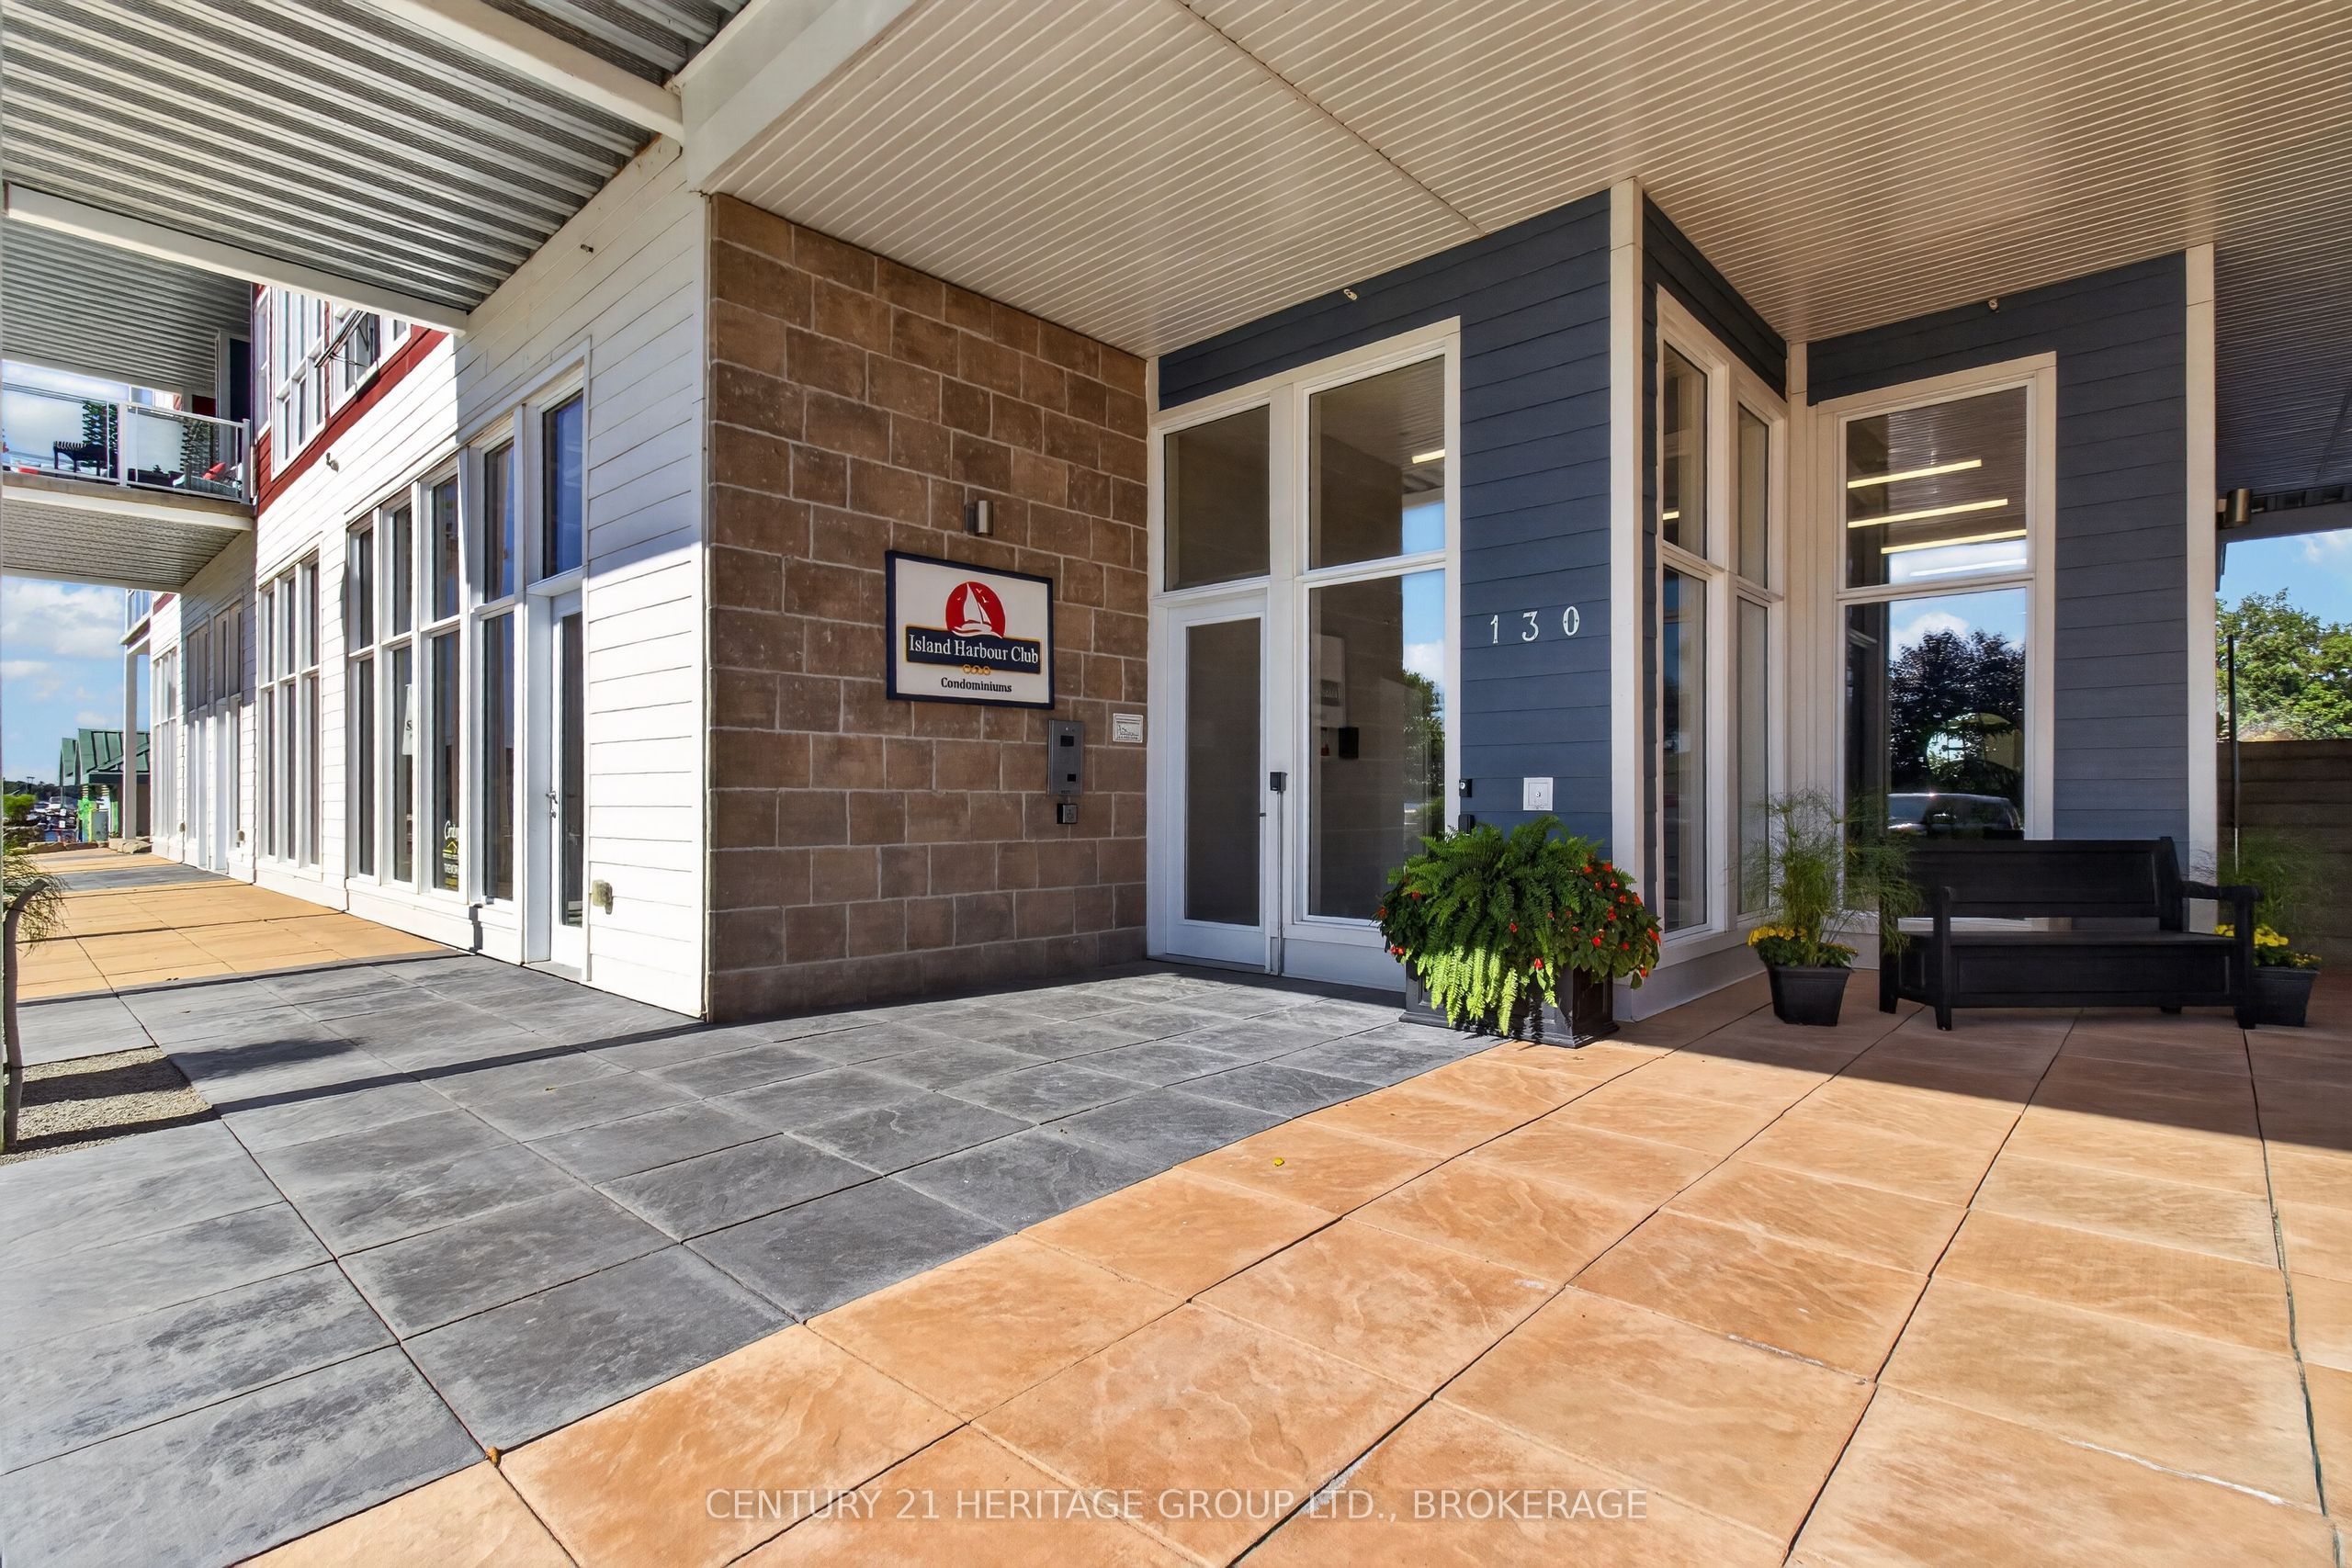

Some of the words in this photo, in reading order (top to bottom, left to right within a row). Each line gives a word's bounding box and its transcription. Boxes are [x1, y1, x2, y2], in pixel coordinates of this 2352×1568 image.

[1490, 605, 1580, 644] 130
[909, 634, 951, 655] Island
[954, 639, 1009, 660] Harbour
[1011, 646, 1038, 664] Club
[941, 677, 1012, 693] Condominiums
